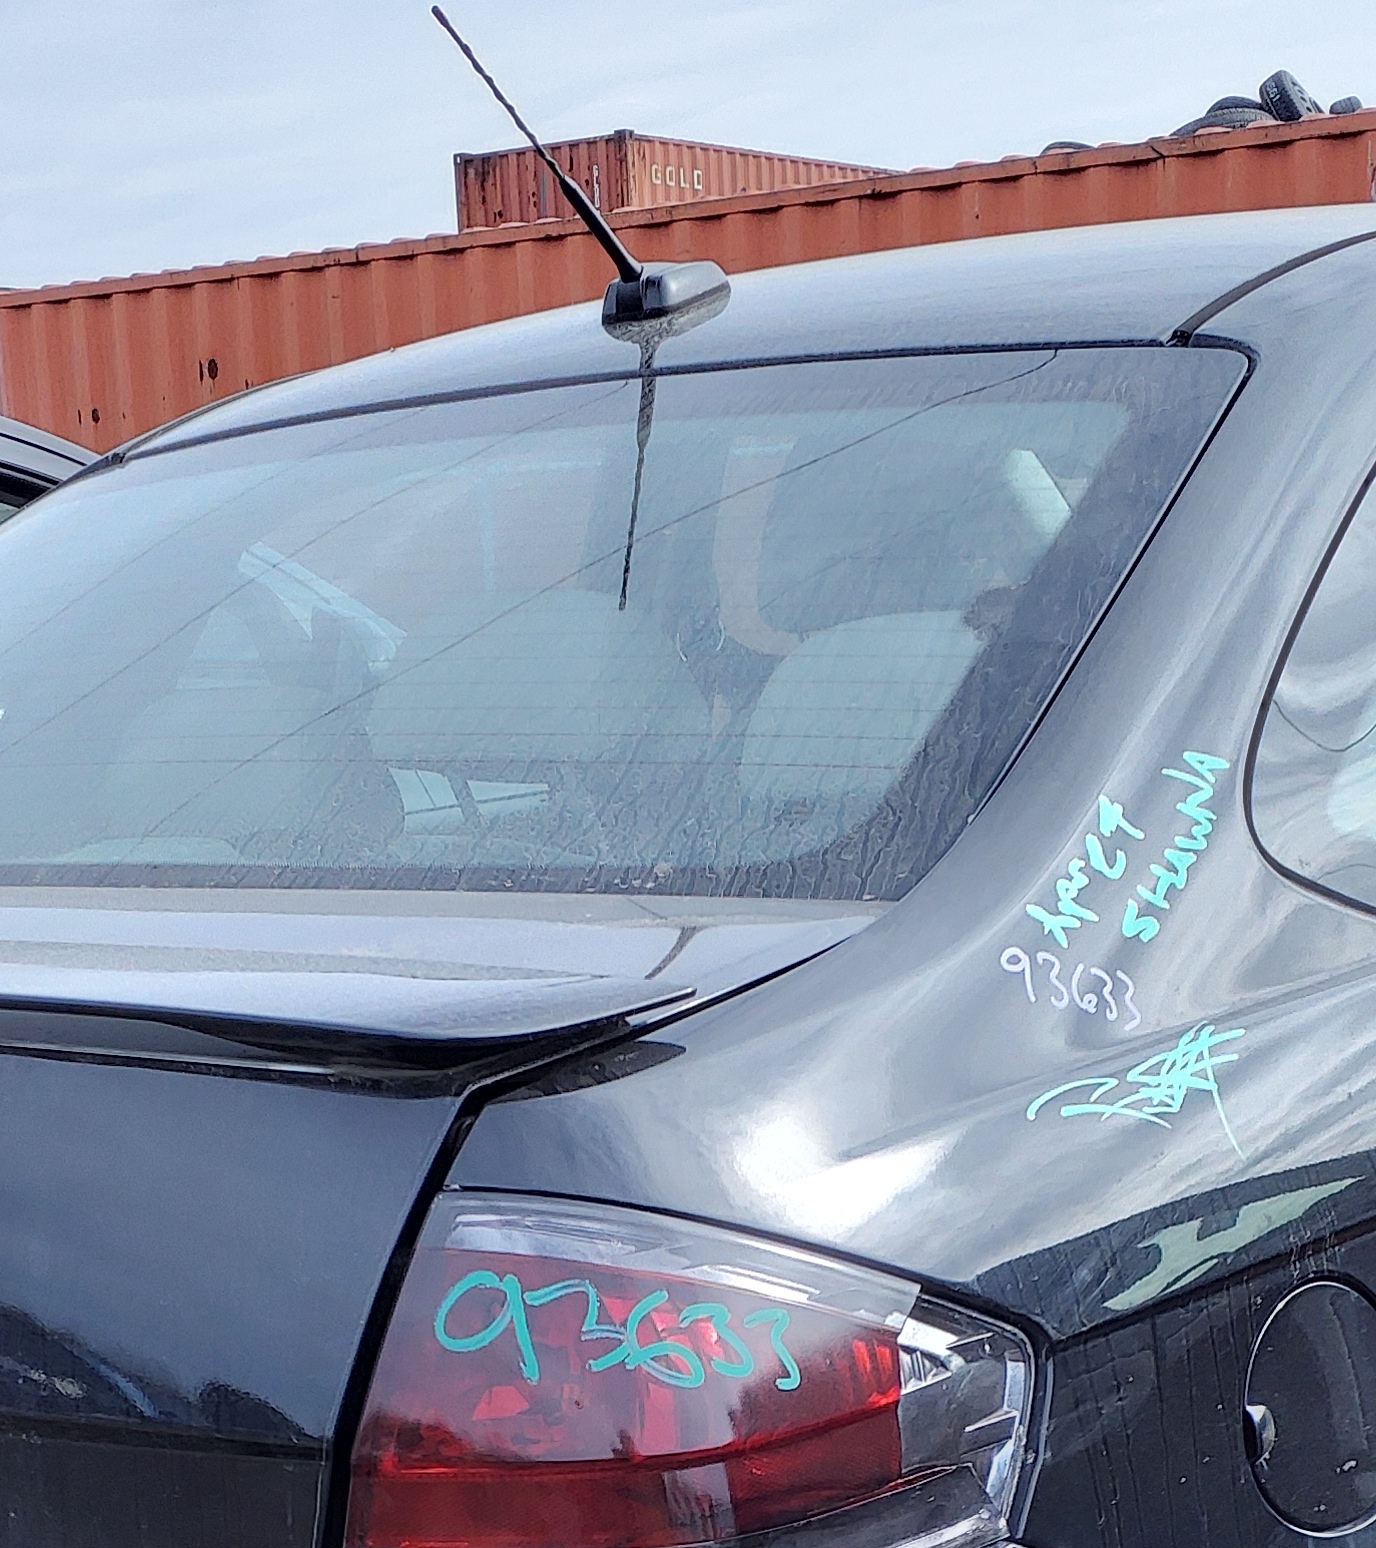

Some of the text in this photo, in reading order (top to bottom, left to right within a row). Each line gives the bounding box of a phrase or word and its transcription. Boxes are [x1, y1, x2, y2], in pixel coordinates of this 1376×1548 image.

[651, 163, 703, 190] GOLD
[999, 945, 1143, 1032] 93633
[433, 1269, 802, 1392] 93633
